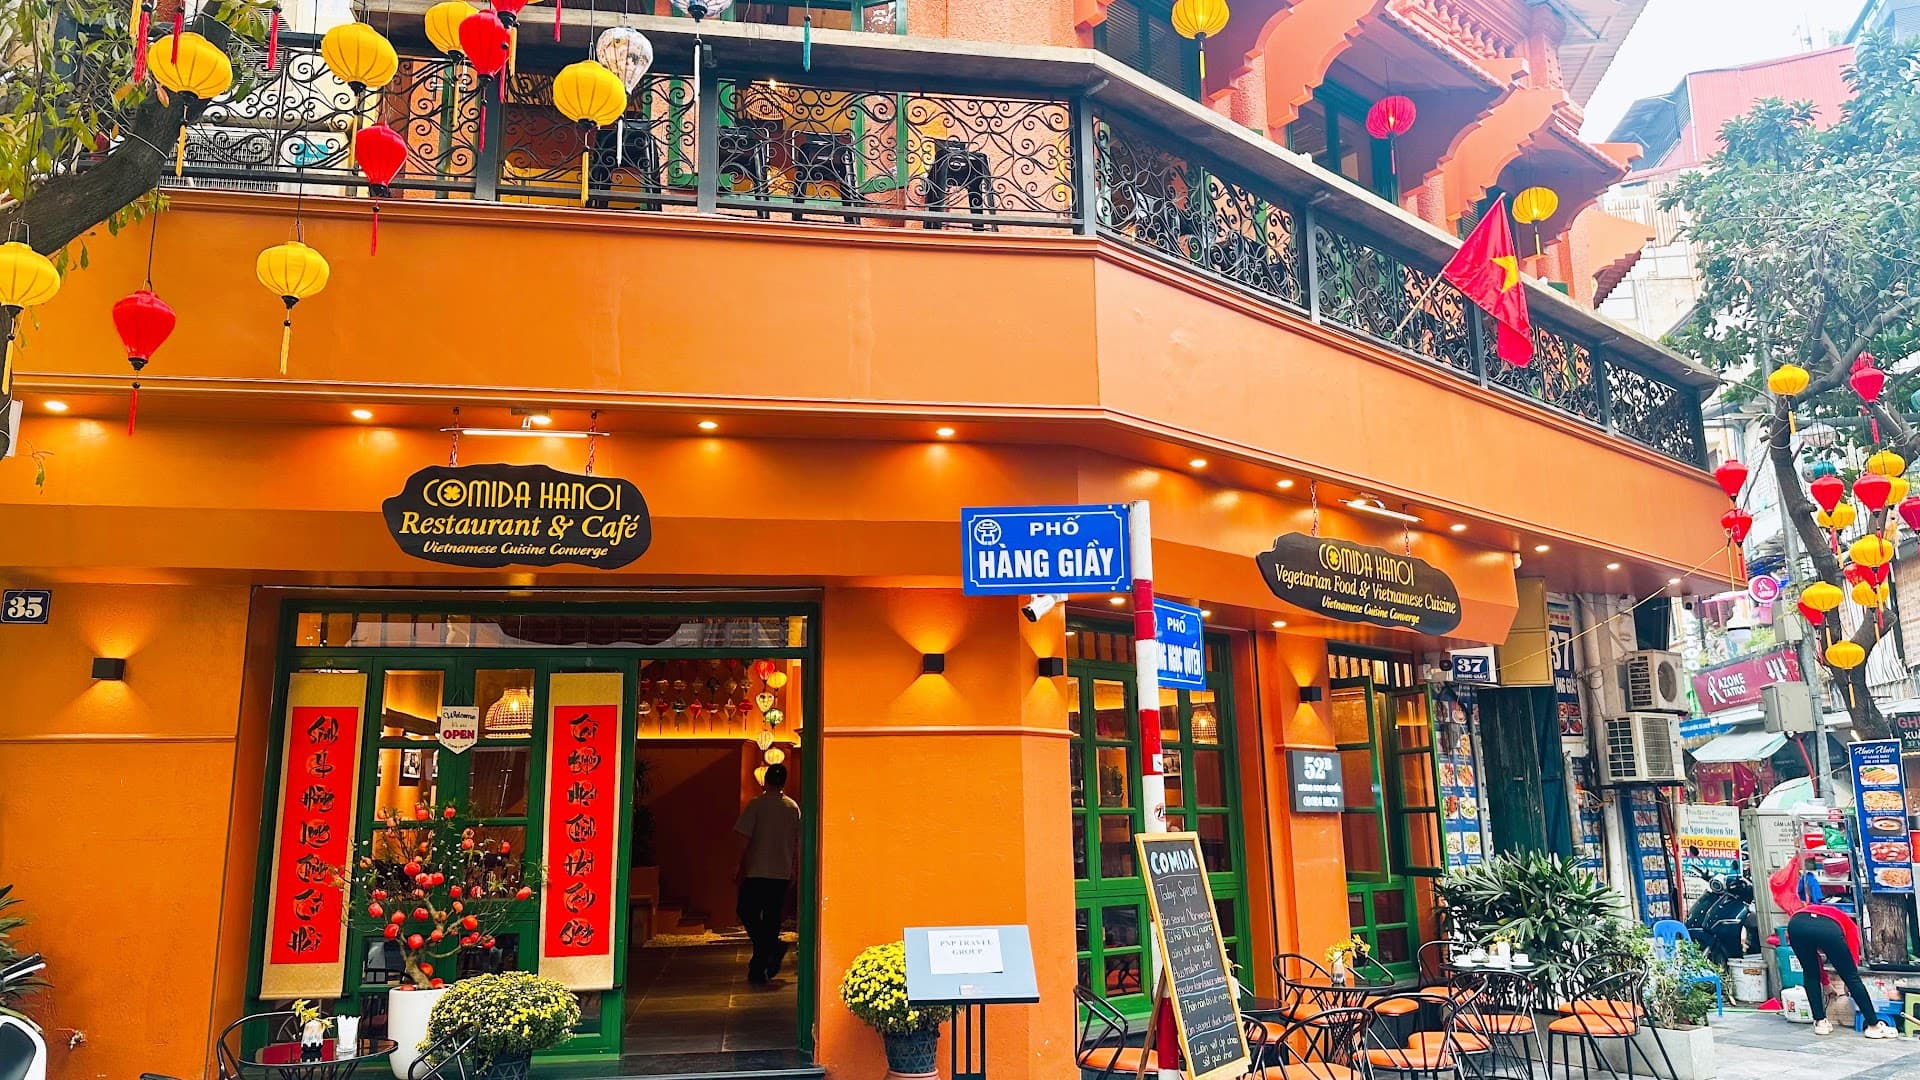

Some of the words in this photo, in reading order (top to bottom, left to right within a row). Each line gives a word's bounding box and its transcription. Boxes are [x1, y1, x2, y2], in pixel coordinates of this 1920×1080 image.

[423, 478, 531, 509] COMIDA
[540, 481, 621, 511] HANOI
[398, 511, 542, 537] Restaurant
[548, 514, 574, 540] &
[581, 514, 640, 546] Café
[1029, 515, 1081, 537] PHỐ
[423, 540, 497, 554] Vietnamese
[500, 542, 547, 556] Cuisine
[549, 543, 609, 559] Converge
[978, 543, 1050, 579] HÀNG
[1058, 539, 1115, 578] GIẦY
[1318, 543, 1373, 578] COMIDA
[1374, 554, 1415, 587] HANOI
[1275, 563, 1332, 590] Vegetarian
[1333, 574, 1358, 596] Food
[1358, 580, 1371, 599] &
[1372, 582, 1424, 608] Vietnamese
[1424, 593, 1457, 615] Cuisine
[7, 596, 43, 618] 35
[1321, 594, 1363, 614] Vietnamese
[1363, 603, 1389, 619] Cuisine
[1389, 607, 1420, 627] Converge
[1166, 613, 1186, 634] PHỐ
[1457, 658, 1484, 673] 37
[1717, 673, 1746, 690] AZONE
[1722, 684, 1747, 698] TATTOO
[1897, 716, 1920, 729] GH
[443, 730, 475, 739] OPEN
[1698, 848, 1737, 859] XCHANGE
[1706, 839, 1737, 849] OFFICE
[1150, 848, 1199, 875] COMIDA
